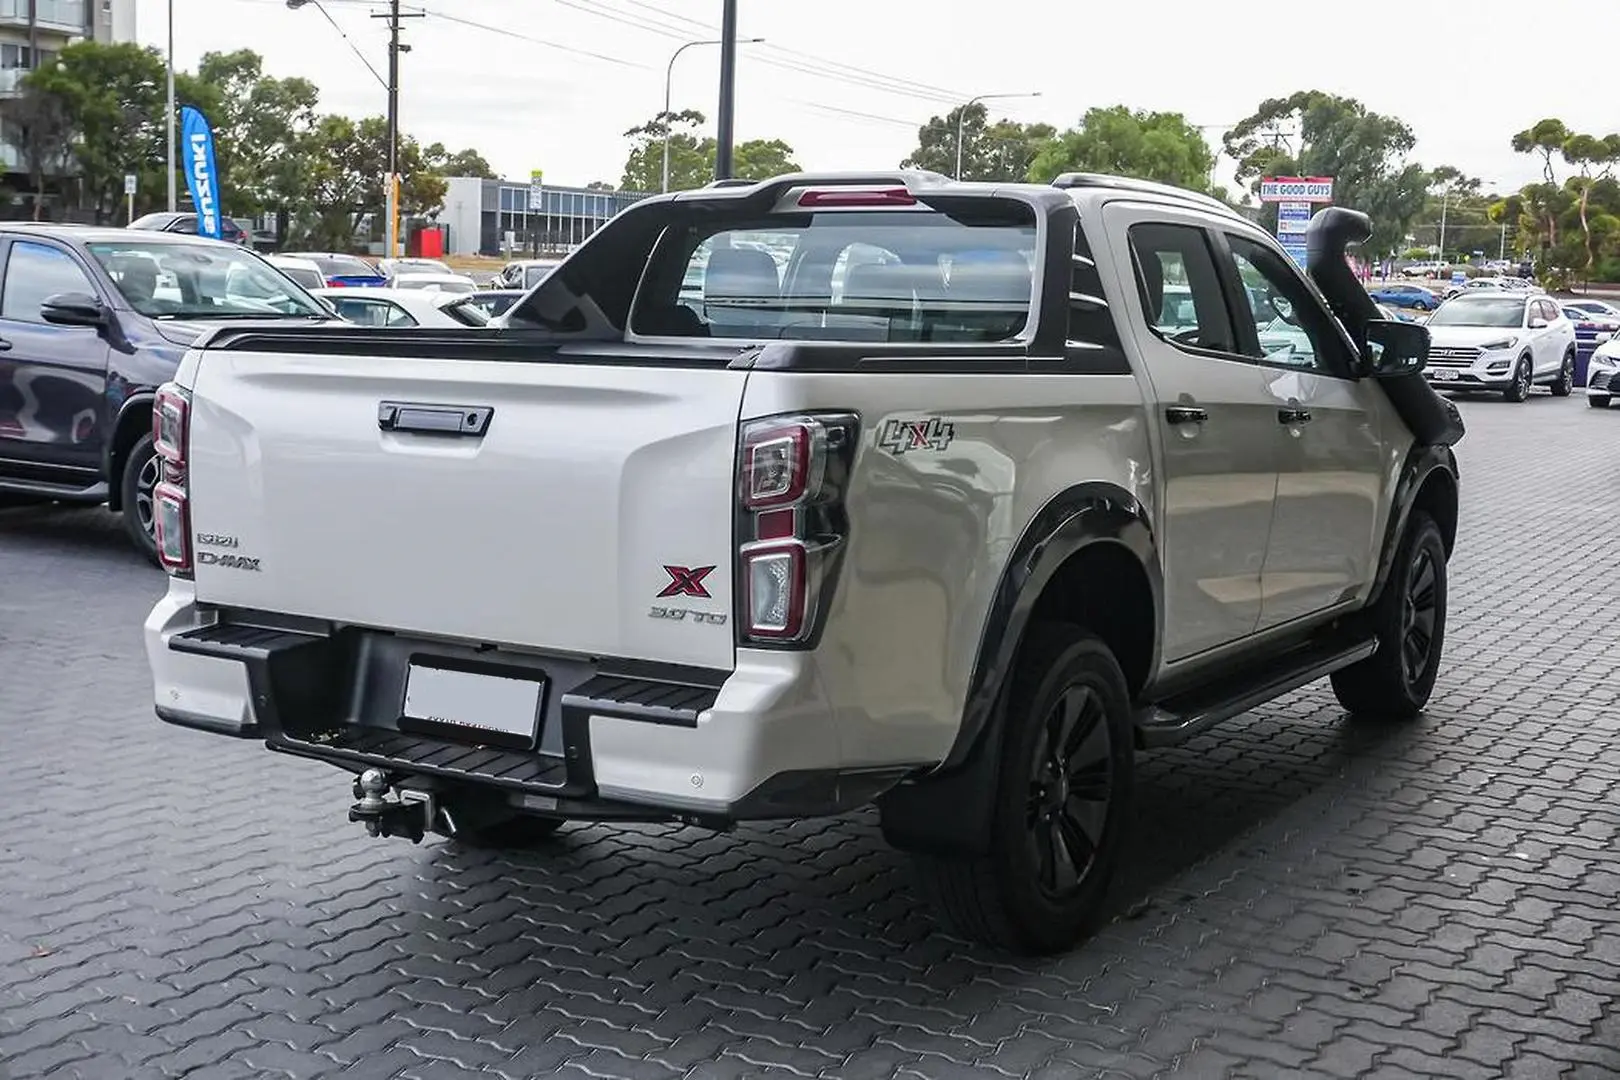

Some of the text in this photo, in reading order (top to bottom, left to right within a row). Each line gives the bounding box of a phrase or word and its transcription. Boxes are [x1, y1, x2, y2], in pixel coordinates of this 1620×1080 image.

[1262, 185, 1330, 195] THE GOOD GUYS
[197, 552, 262, 572] D-MAX
